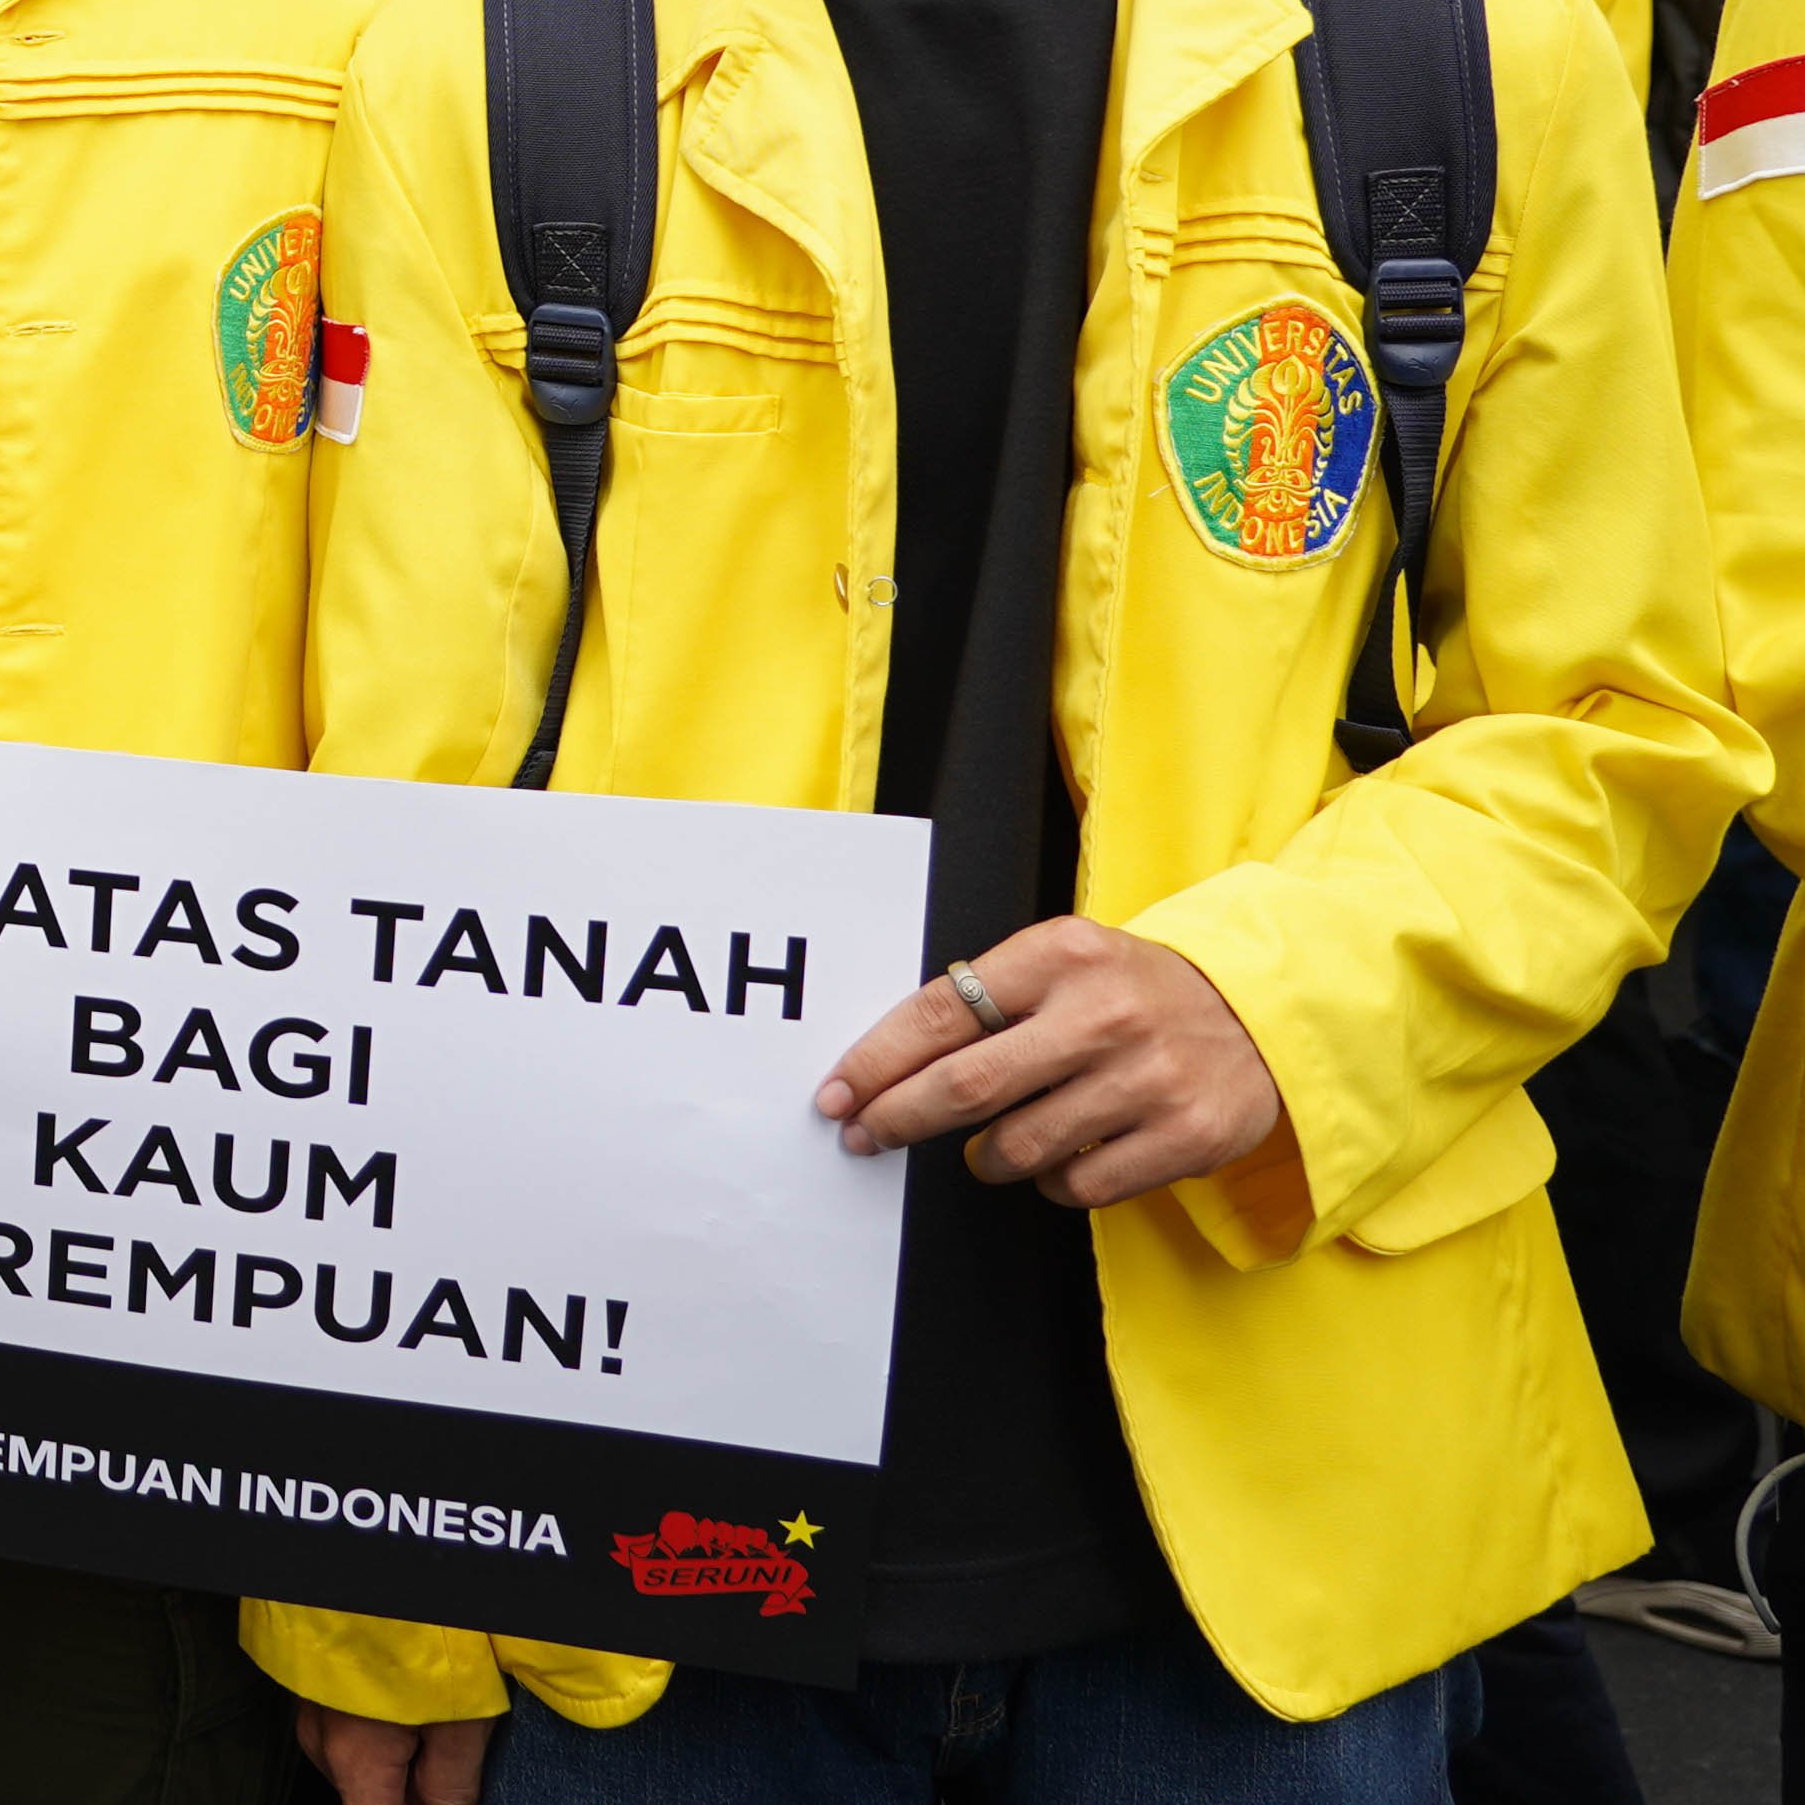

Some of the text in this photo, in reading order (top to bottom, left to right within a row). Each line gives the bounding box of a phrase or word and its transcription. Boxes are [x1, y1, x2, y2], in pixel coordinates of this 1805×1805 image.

[1184, 320, 1363, 416] UNIVERSITAS
[1193, 471, 1348, 555] INDONESIA
[351, 899, 806, 1020] TANAH
[71, 996, 372, 1105] BAGI
[34, 1112, 396, 1229] KAUM
[240, 1473, 566, 1555] INDONESIA
[643, 1566, 793, 1587] SERUNI
